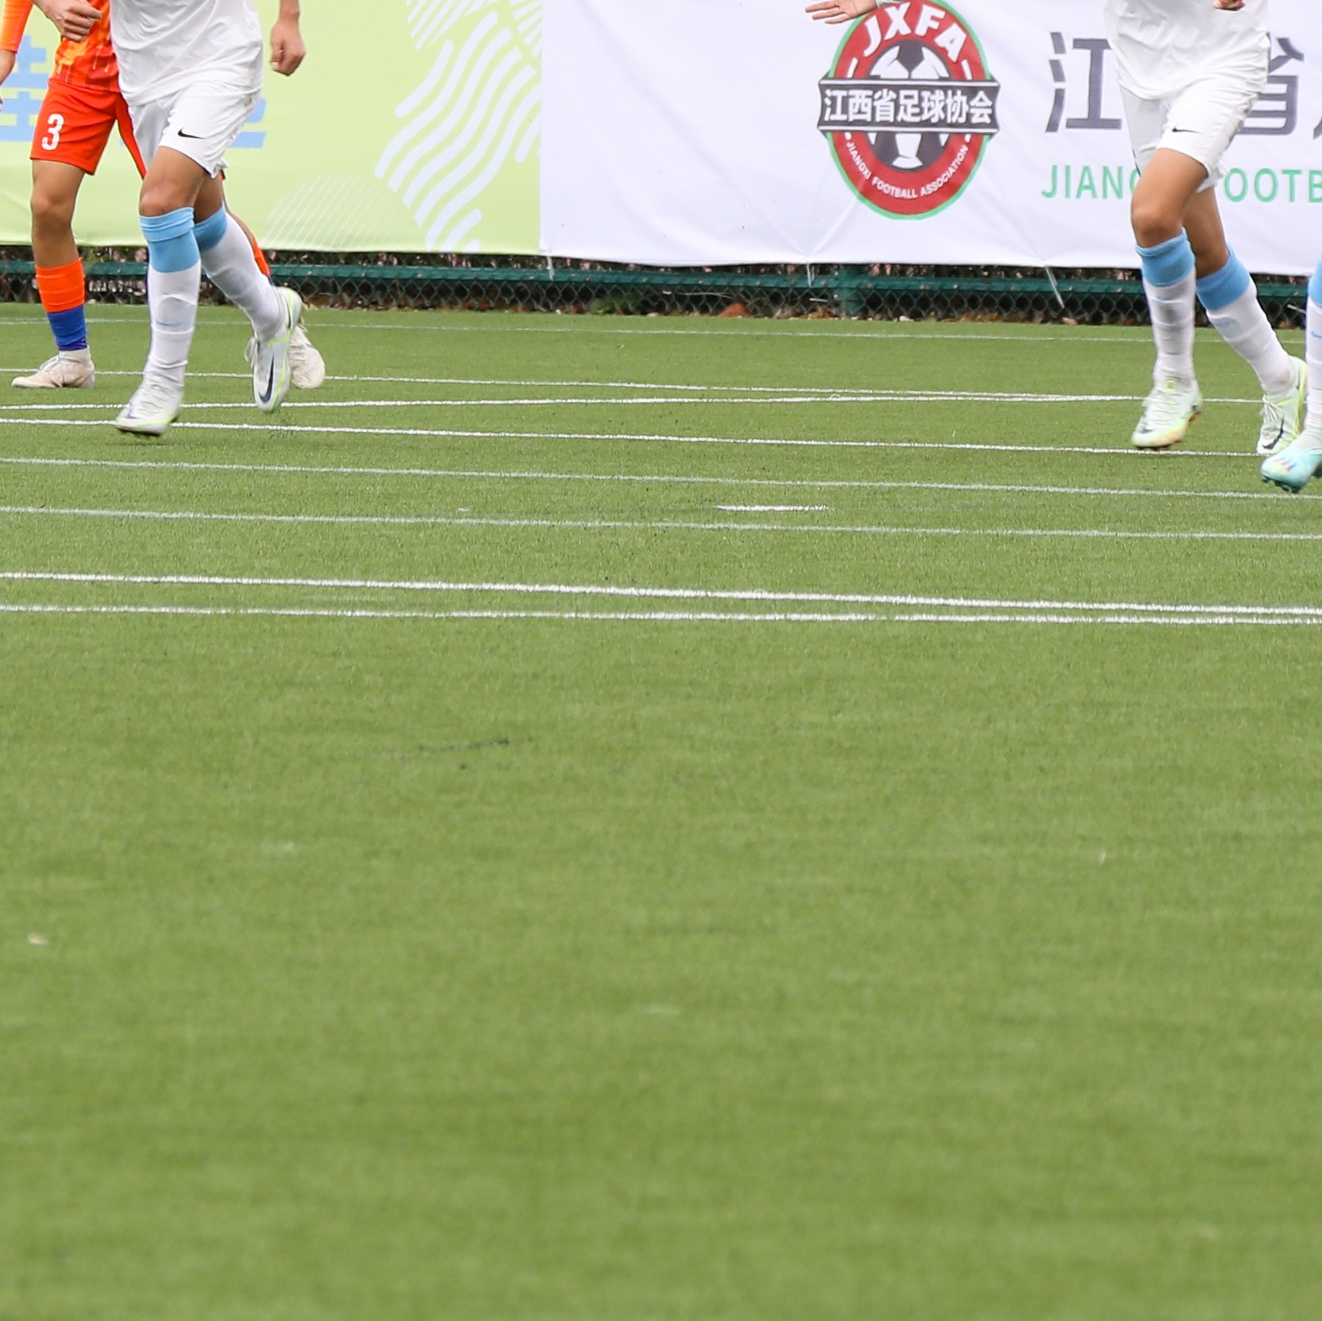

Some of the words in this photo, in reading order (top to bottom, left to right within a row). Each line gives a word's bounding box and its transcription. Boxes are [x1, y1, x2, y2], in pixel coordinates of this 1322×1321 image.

[862, 1, 968, 63] JXFA
[823, 88, 994, 125] 江西省足球协会
[40, 113, 65, 151] 3
[846, 141, 872, 180] JIANGXI
[871, 175, 919, 200] FOOTBALL
[919, 145, 969, 198] ASSOCIATION
